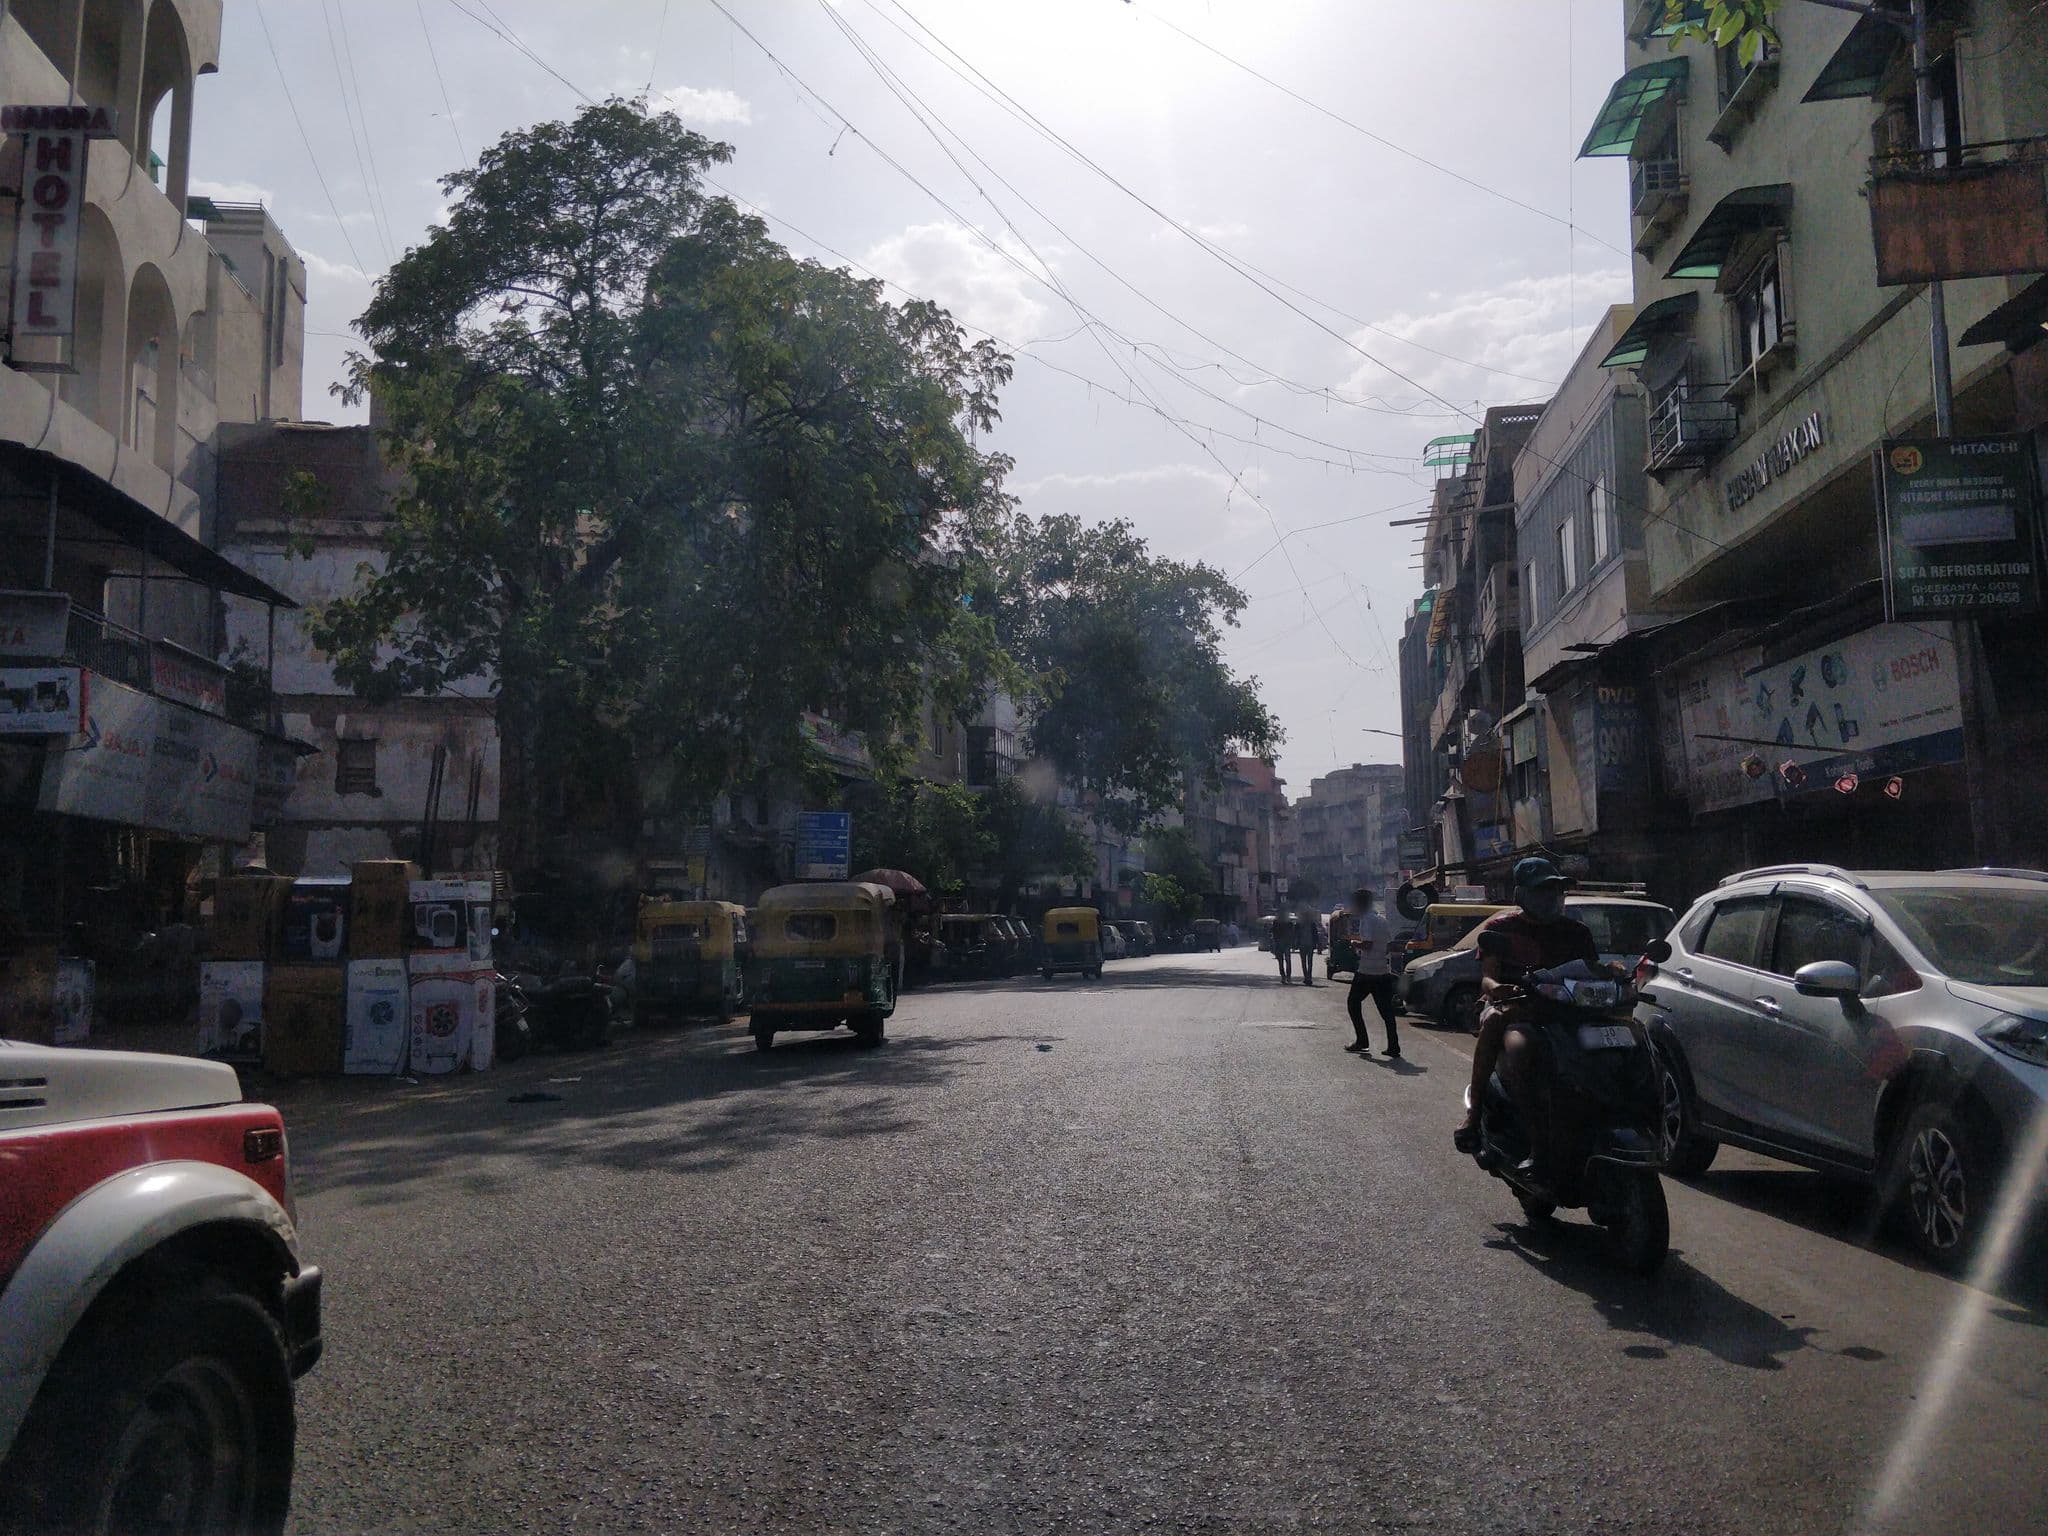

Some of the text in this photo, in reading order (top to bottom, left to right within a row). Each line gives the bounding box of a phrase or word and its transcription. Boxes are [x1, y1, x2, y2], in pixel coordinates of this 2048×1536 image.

[28, 137, 72, 326] HOTEL
[1950, 441, 2018, 456] HITACHI
[1930, 562, 2030, 578] REFRIGERATION
[1890, 647, 1939, 682] BOSCH
